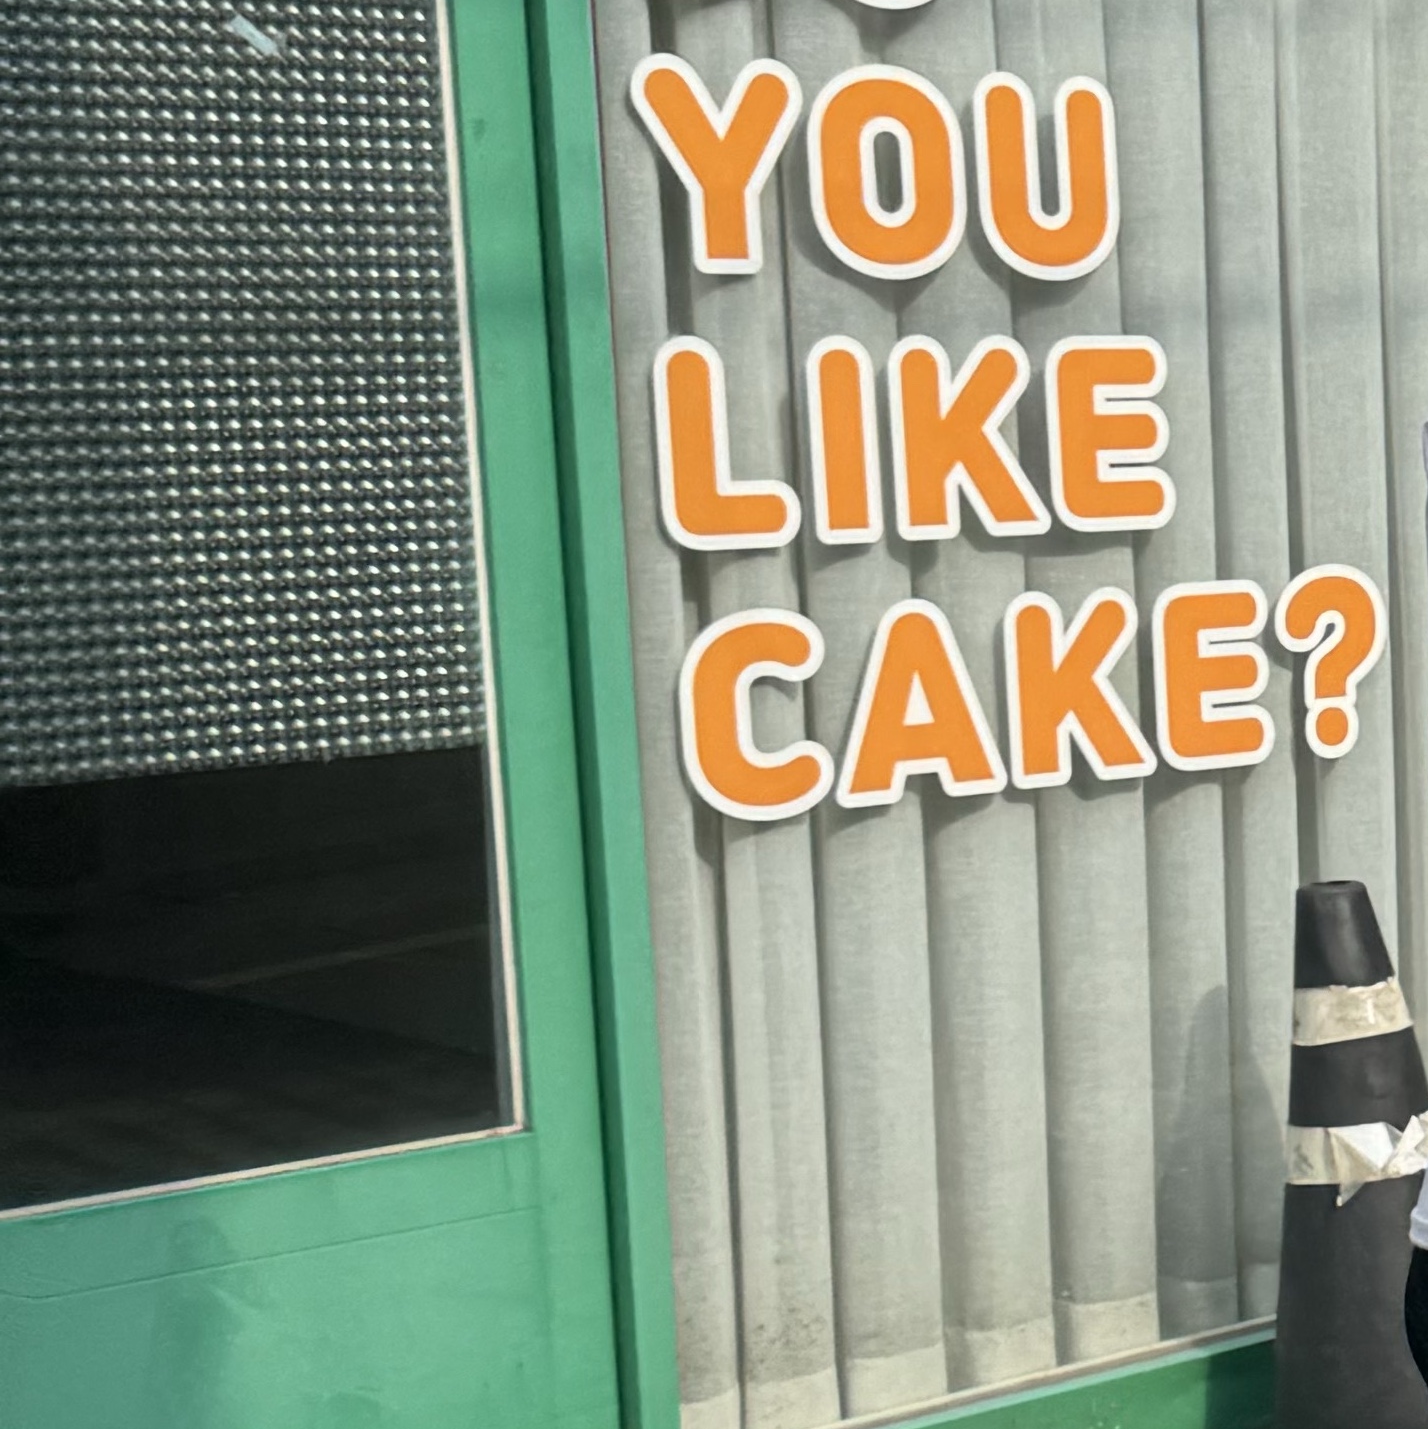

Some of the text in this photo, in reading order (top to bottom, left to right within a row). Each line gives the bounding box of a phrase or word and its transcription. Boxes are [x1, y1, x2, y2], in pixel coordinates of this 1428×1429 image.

[630, 53, 1120, 281] YOU
[653, 335, 1176, 550] LIKE
[679, 564, 1386, 821] CAKE?
